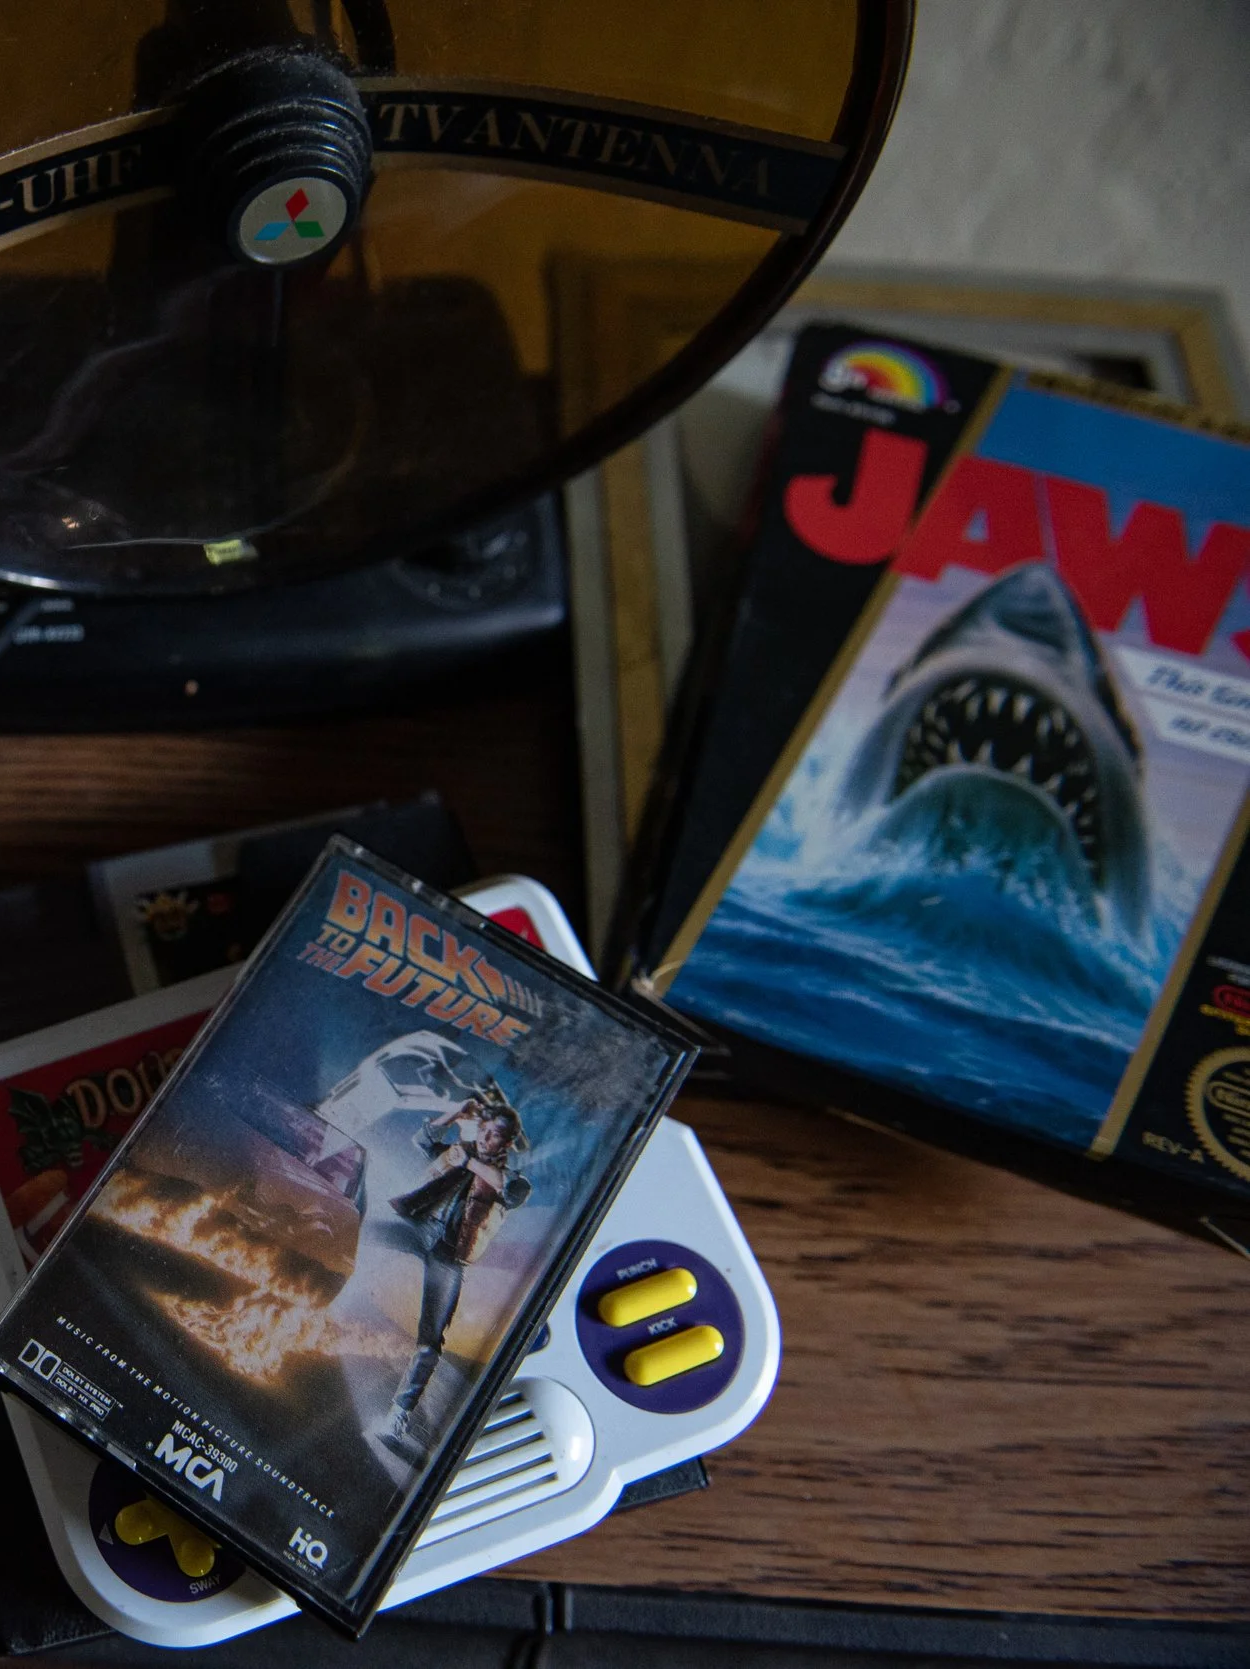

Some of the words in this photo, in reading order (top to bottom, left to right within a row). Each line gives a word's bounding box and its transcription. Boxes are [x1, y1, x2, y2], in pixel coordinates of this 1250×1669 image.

[378, 102, 465, 144] TV
[464, 106, 772, 198] ANTENNA
[297, 942, 347, 974] THE
[315, 922, 357, 956] TO
[325, 868, 508, 1004] BACK
[335, 941, 533, 1049] FUTURE
[616, 1257, 658, 1281] PUNCH
[647, 1316, 678, 1337] KICK
[55, 1315, 95, 1345] MUSIC
[94, 1343, 128, 1370] FROM
[128, 1366, 152, 1387] THE
[152, 1384, 200, 1423] MOTION
[200, 1419, 254, 1460] PICTURE
[254, 1457, 336, 1519] SOUNDTRACK
[153, 1431, 225, 1503] MCA
[171, 1419, 239, 1474] MCAC-39300
[188, 1573, 222, 1596] SWAY
